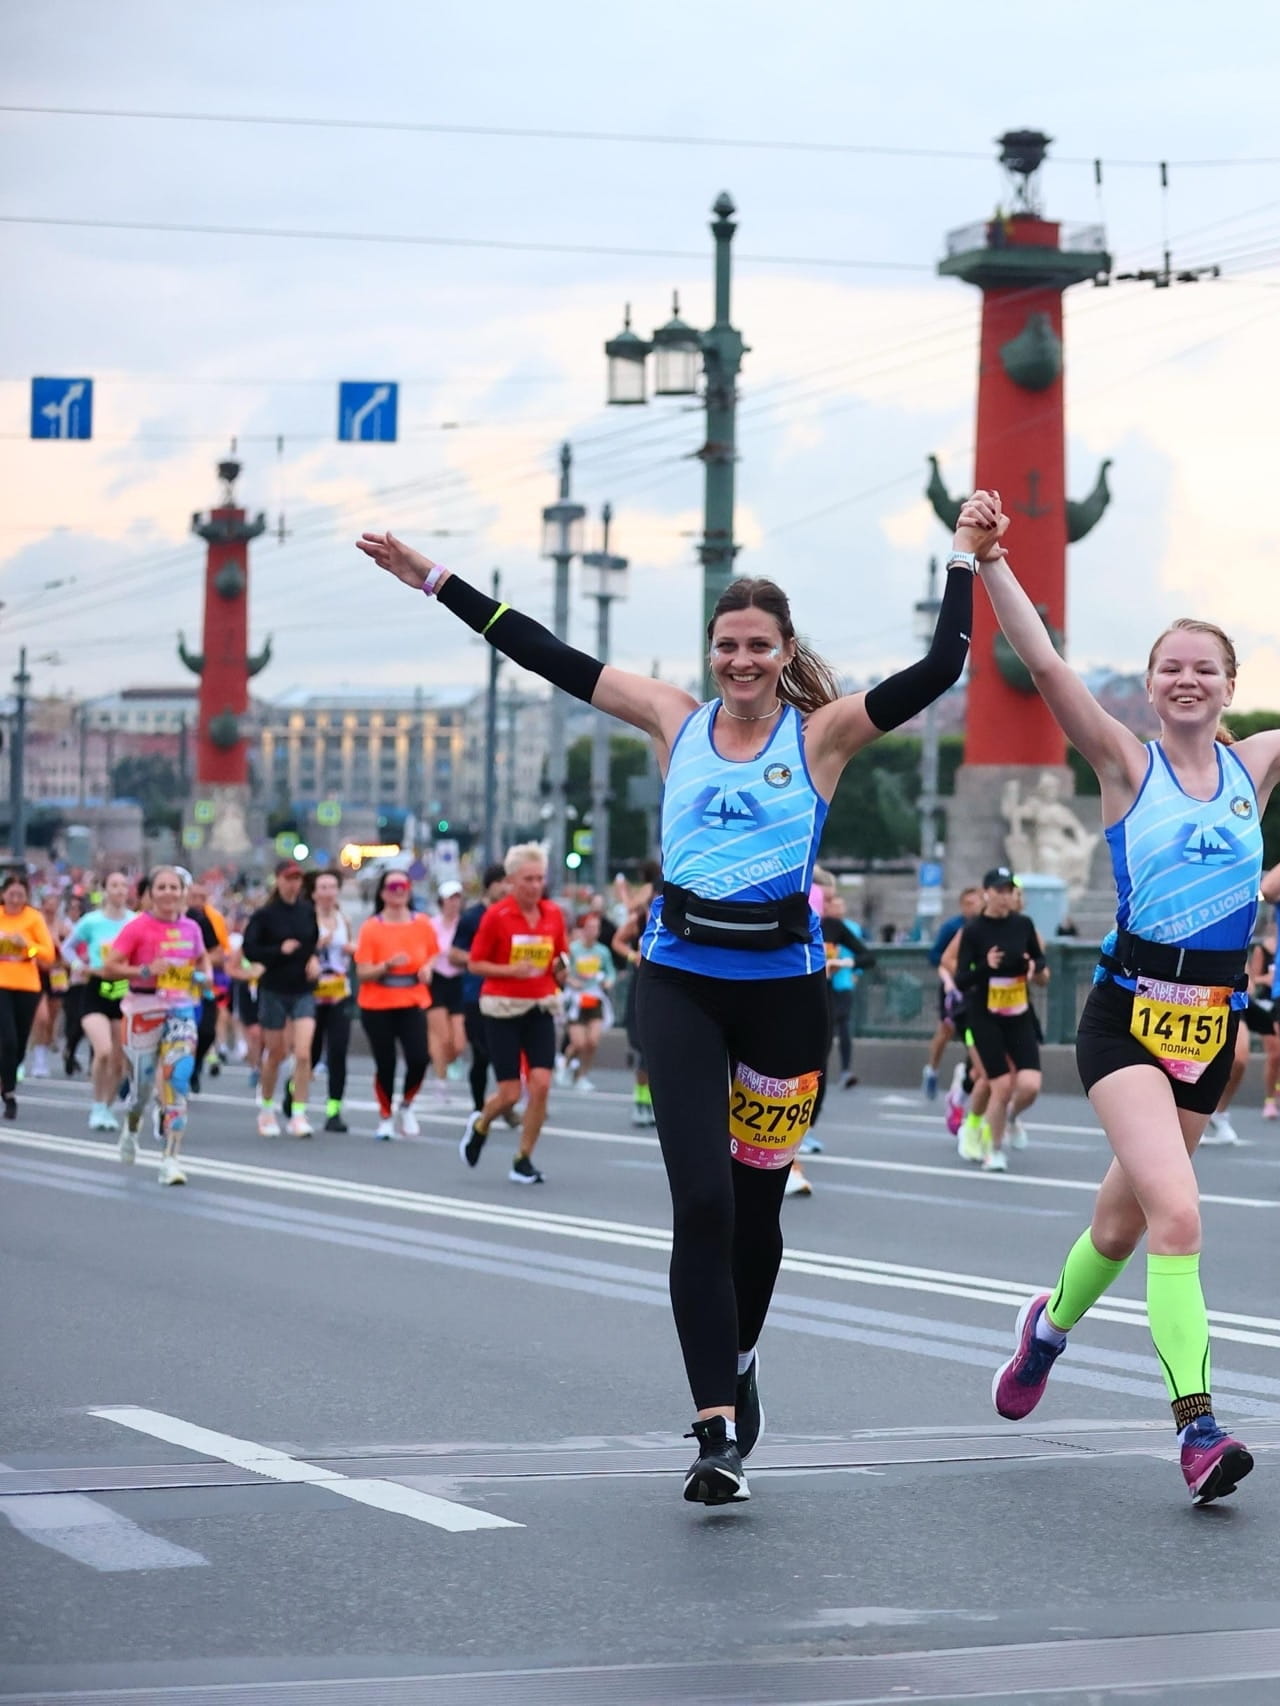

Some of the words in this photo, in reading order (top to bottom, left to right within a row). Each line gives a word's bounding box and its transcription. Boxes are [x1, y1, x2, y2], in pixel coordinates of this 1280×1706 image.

[1211, 886, 1251, 916] LIONS
[1176, 986, 1211, 999] НОЧИ
[1138, 1007, 1224, 1045] 14151
[1160, 1043, 1201, 1056] ПОЛИНА
[765, 1078, 799, 1092] НОЧИ
[731, 1091, 813, 1133] 22798
[753, 1133, 787, 1144] ДАРЬЯ
